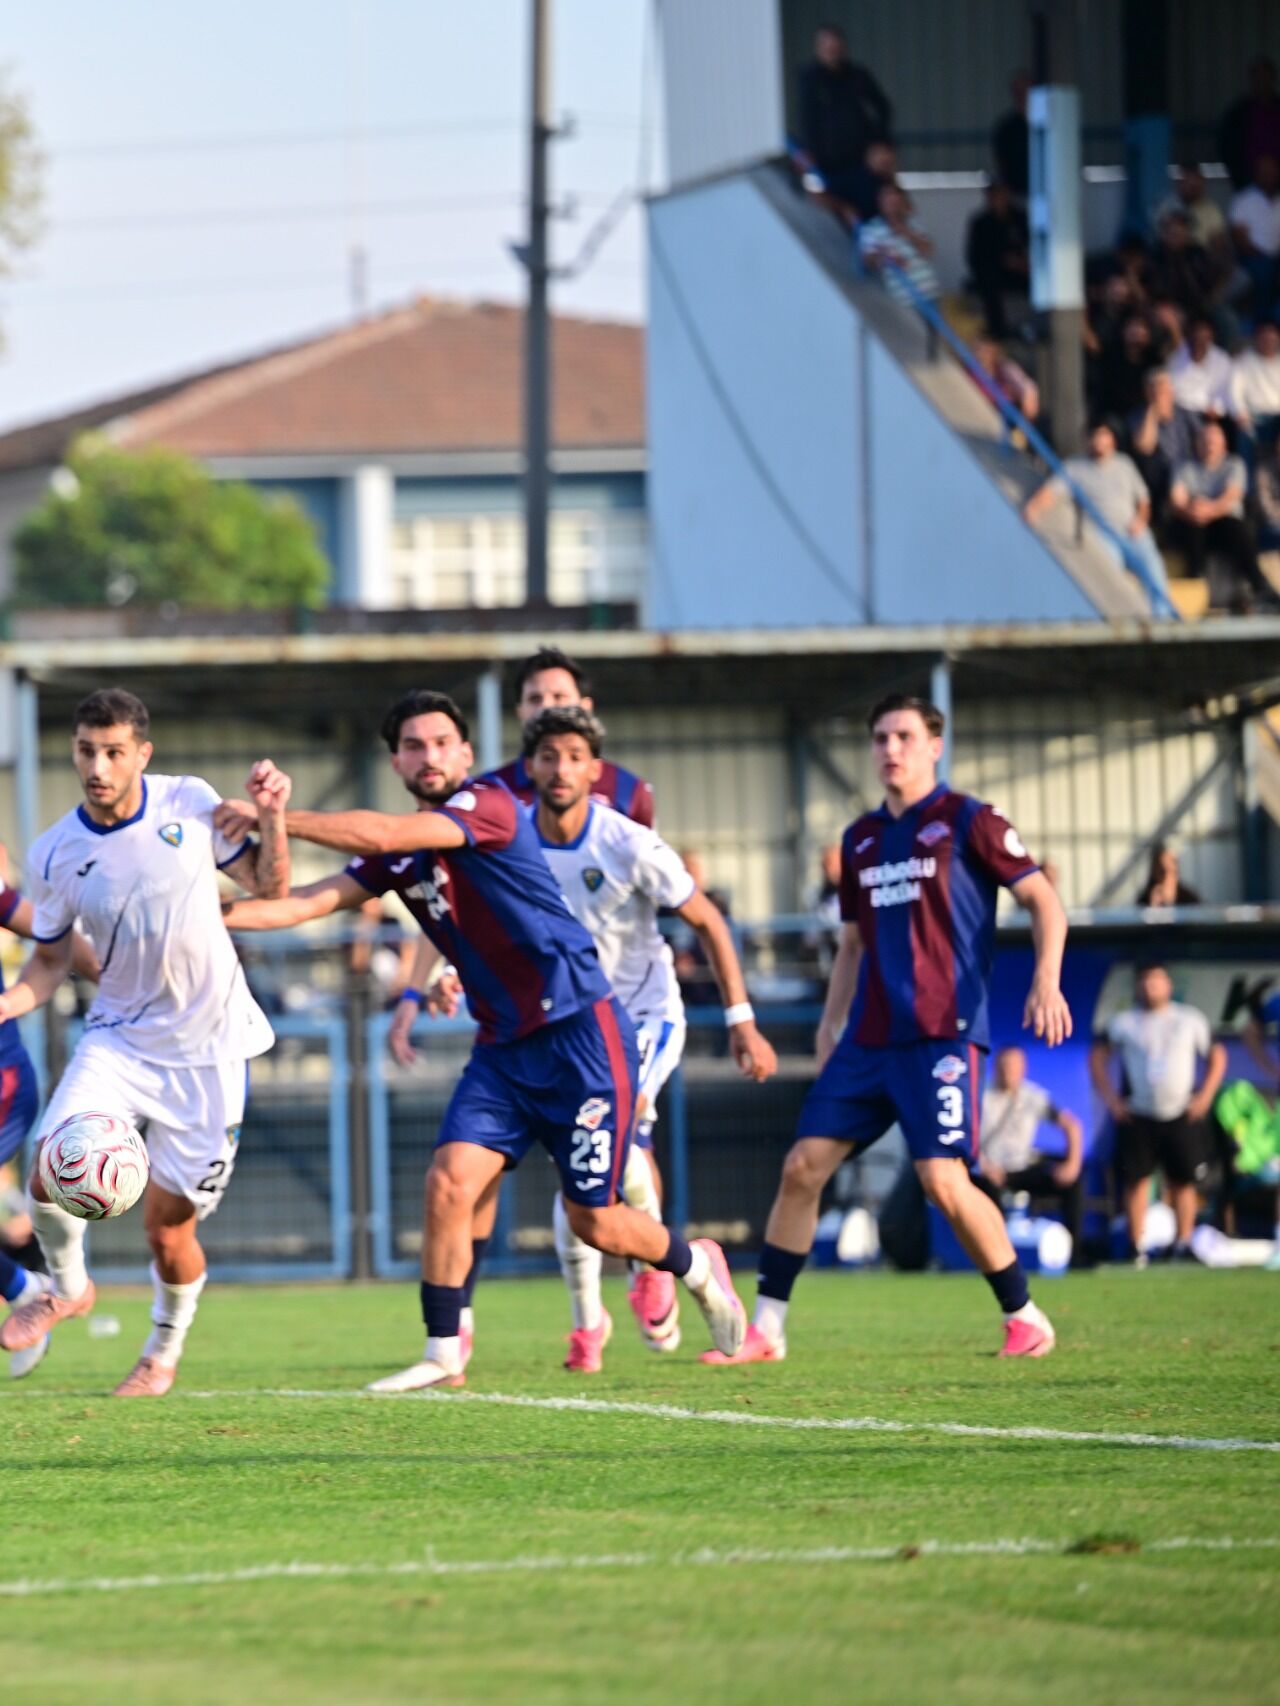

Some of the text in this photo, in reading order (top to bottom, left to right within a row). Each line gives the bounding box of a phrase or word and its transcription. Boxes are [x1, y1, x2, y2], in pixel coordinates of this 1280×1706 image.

[936, 1085, 964, 1128] 3
[569, 1129, 612, 1174] 23
[196, 1160, 226, 1193] 2
